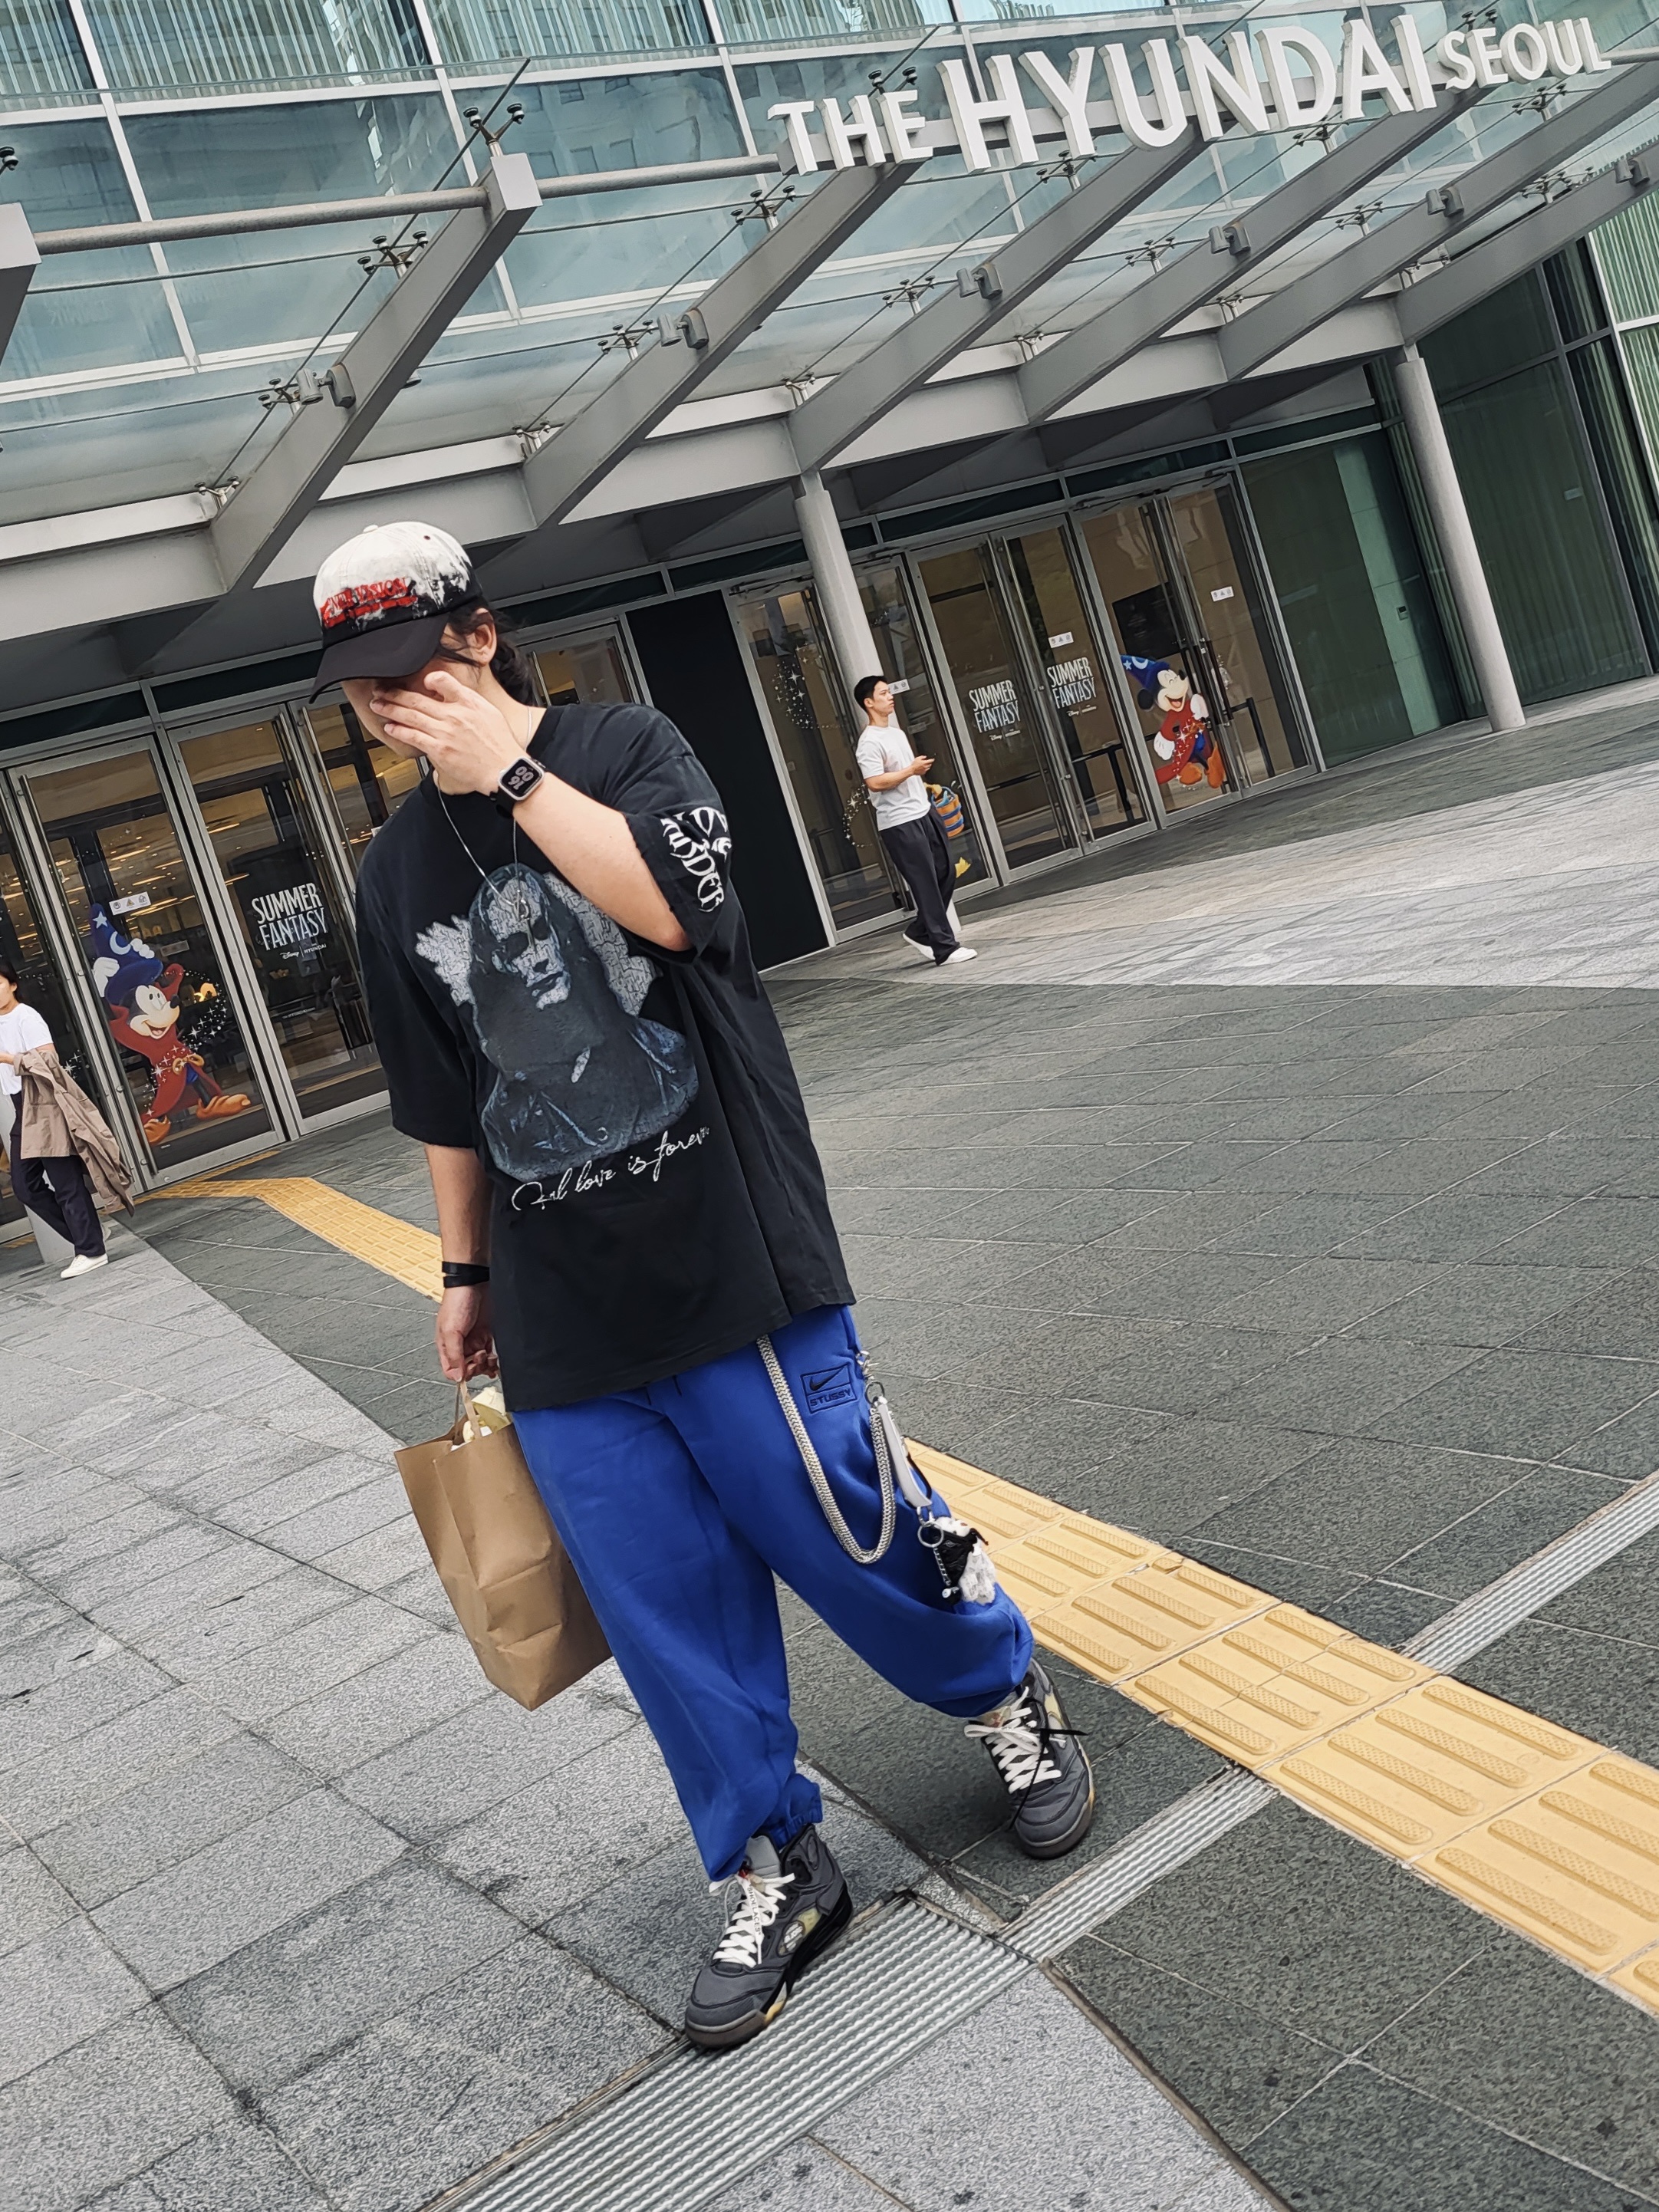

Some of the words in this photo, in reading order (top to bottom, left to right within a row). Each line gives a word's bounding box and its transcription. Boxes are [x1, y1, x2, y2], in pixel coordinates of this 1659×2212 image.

[767, 89, 933, 176] THE
[936, 15, 1437, 173] HYUNDAI
[1436, 17, 1612, 94] SEOUL
[1047, 657, 1093, 688] SUMMER
[969, 680, 1017, 712] SUMMER
[1052, 677, 1097, 709] FANTASY
[974, 699, 1021, 733] FANTASY
[252, 882, 322, 924] SUMMER
[258, 907, 328, 951] FANTASY
[575, 1160, 616, 1192] love
[627, 1155, 650, 1174] is
